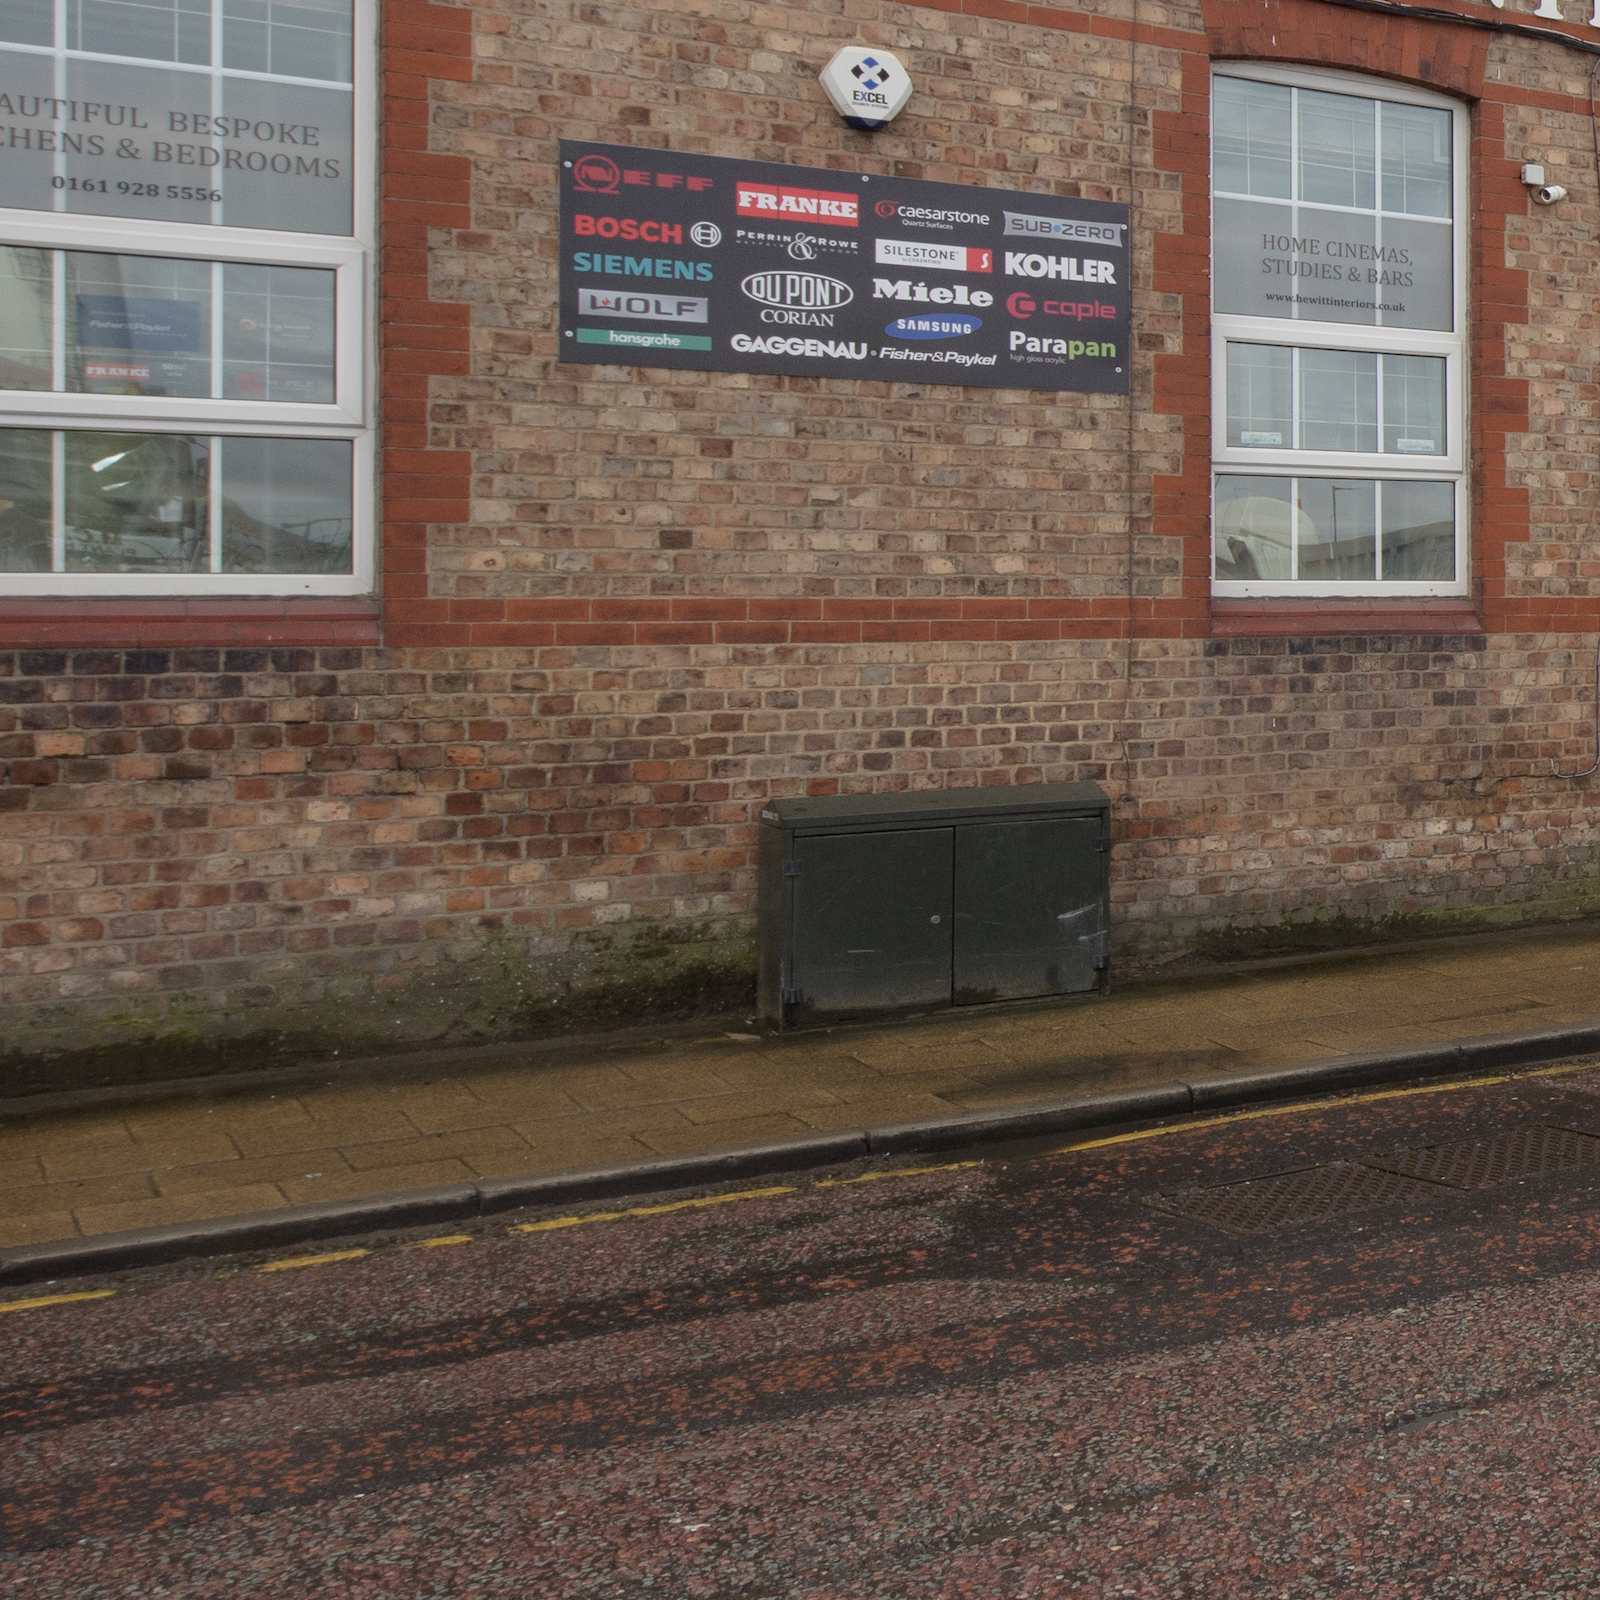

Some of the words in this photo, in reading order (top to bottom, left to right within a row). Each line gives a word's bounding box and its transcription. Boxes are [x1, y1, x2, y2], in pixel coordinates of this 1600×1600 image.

[853, 90, 888, 105] EXCEL
[168, 110, 321, 147] BESPOKE
[0, 126, 105, 157] HENS
[116, 138, 141, 160] &
[153, 141, 341, 180] BEDROOMS
[51, 175, 109, 194] 0161
[117, 180, 160, 198] 928
[166, 185, 222, 203] 5556
[738, 190, 858, 219] FRANKE
[897, 205, 990, 226] caesarstone
[574, 213, 683, 245] BOSCH
[902, 219, 925, 228] Quartz
[925, 221, 954, 230] Surfaces
[736, 229, 791, 242] PERRIN
[787, 232, 818, 261] &
[884, 245, 957, 261] SILESTONE
[1262, 234, 1320, 256] HOME
[1325, 241, 1414, 267] CINEMAS,
[573, 252, 714, 282] SIEMENS
[1005, 251, 1117, 284] KOHLER
[1261, 258, 1343, 281] STUDIES
[1347, 266, 1362, 282] &
[1366, 268, 1414, 288] BARS
[590, 294, 698, 317] WOLF
[872, 278, 994, 307] Miele
[1265, 292, 1406, 313] www.hewittinteriors.co.uk
[760, 309, 835, 328] CORIAN
[1043, 300, 1116, 322] caple
[608, 330, 681, 347] hansgrohe
[897, 318, 972, 335] SAMSUNG
[730, 333, 868, 360] GAGGENAU
[1009, 330, 1117, 360] Parapan
[86, 366, 150, 378] FRANKE
[1009, 354, 1025, 363] high
[1026, 354, 1043, 363] gloss
[1044, 355, 1066, 365] acrylic
